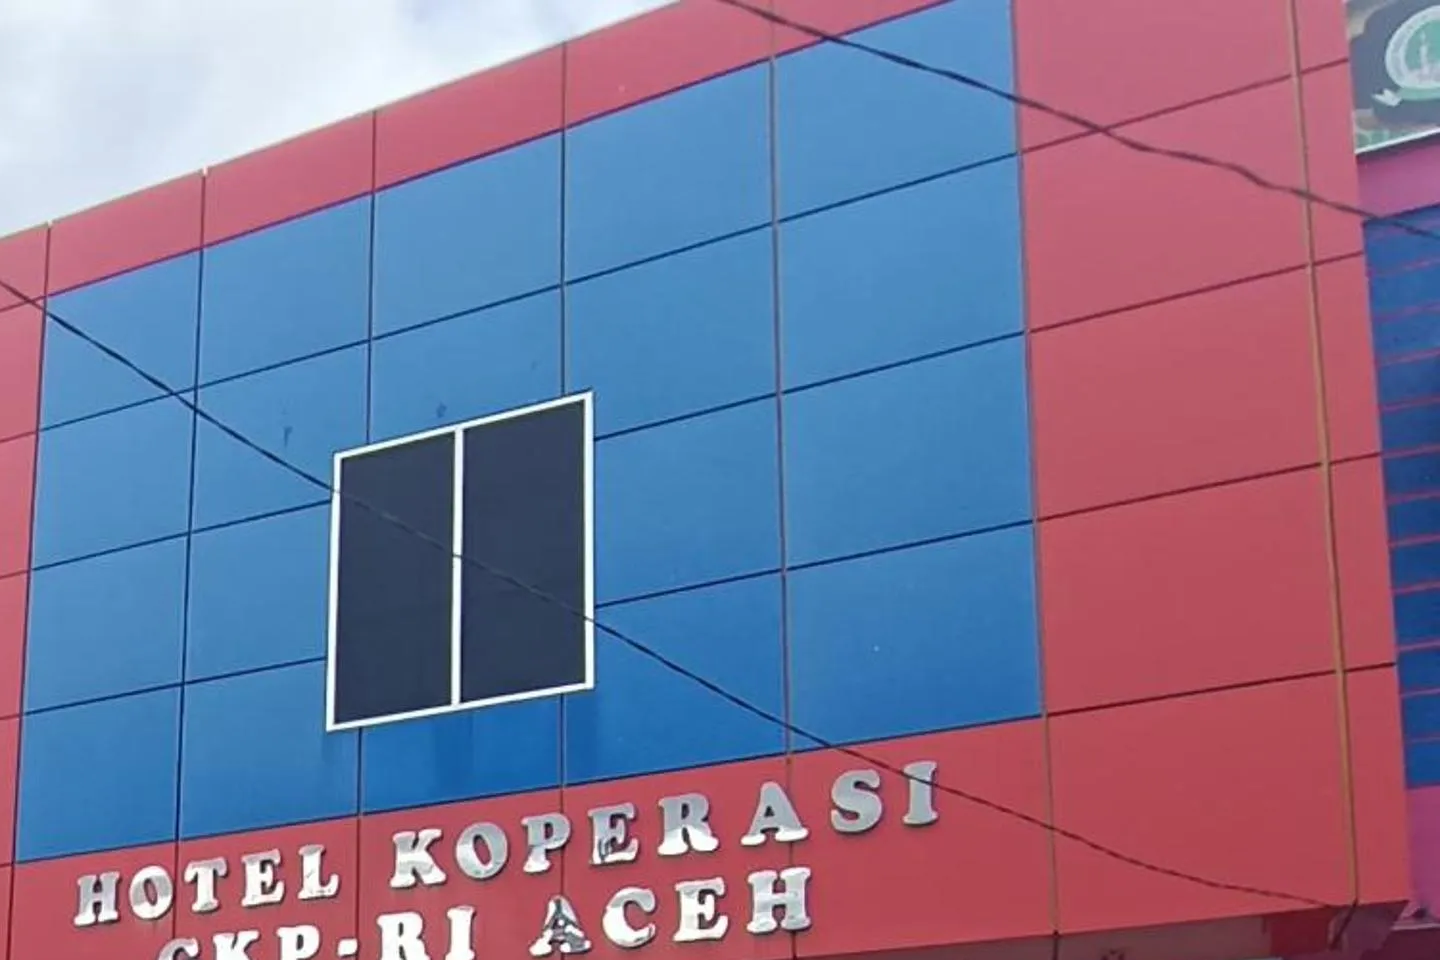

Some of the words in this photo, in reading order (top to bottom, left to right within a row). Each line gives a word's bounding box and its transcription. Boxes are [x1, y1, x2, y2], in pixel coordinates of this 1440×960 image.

[73, 844, 340, 928] HOTEL
[389, 761, 938, 890] KOPERASI
[529, 866, 812, 958] ACEH
